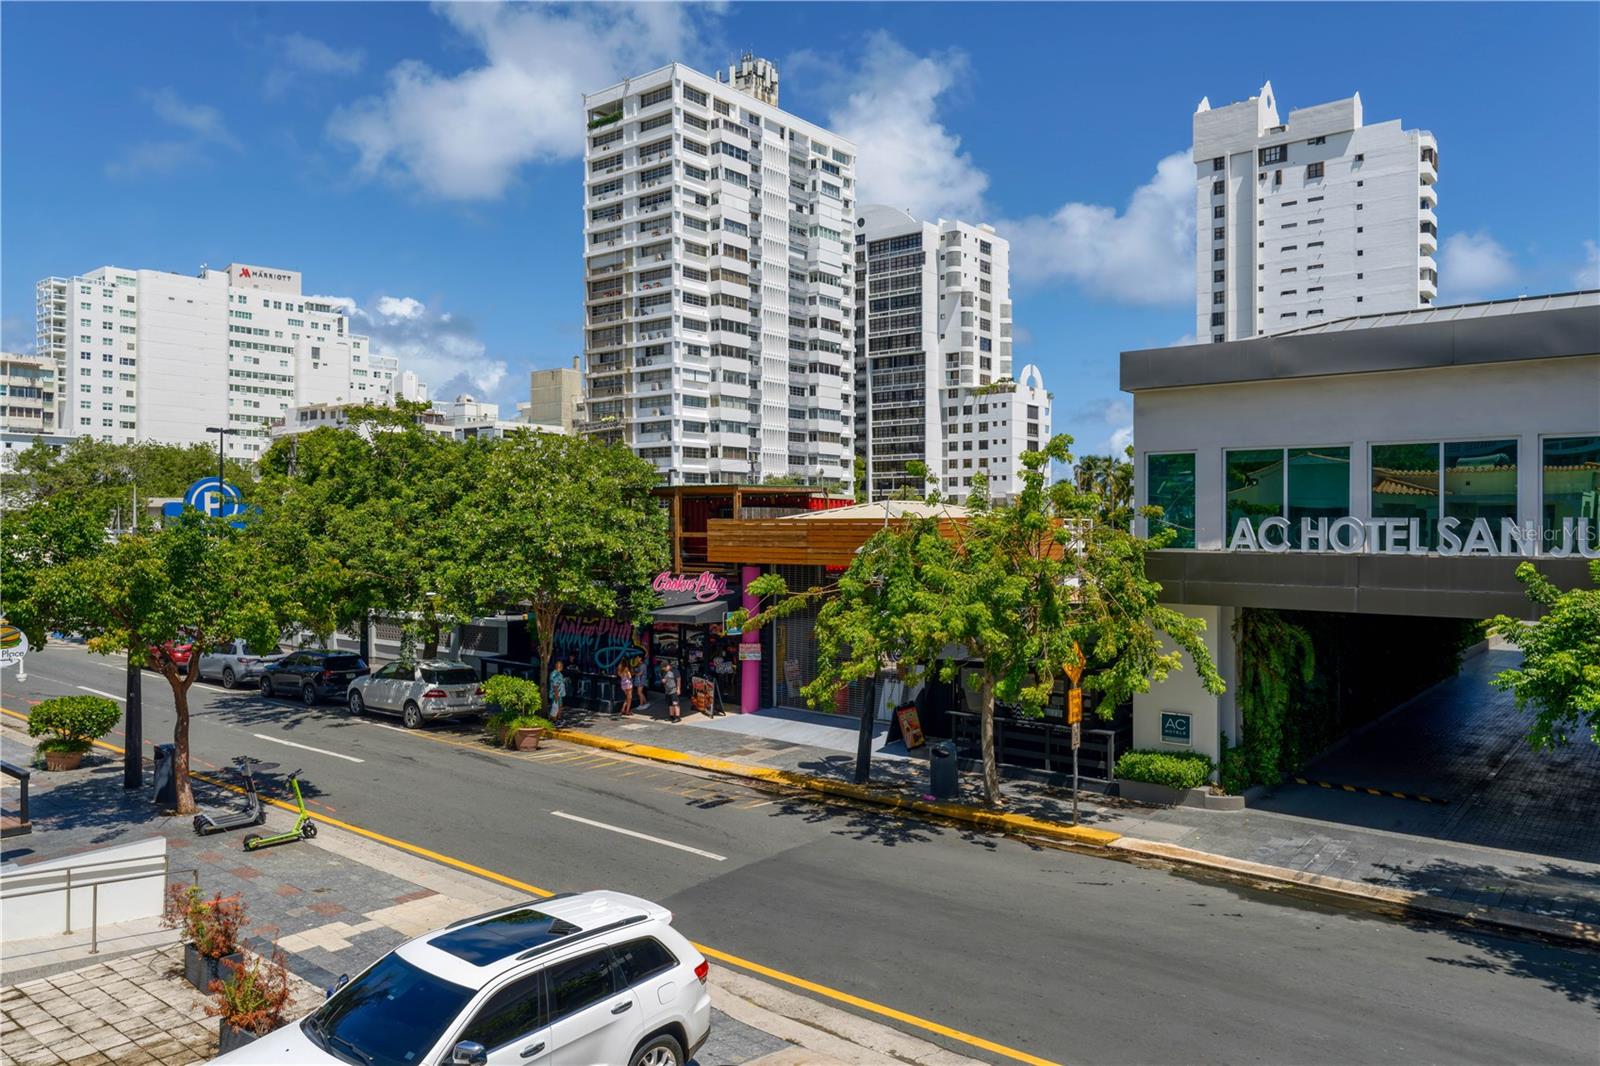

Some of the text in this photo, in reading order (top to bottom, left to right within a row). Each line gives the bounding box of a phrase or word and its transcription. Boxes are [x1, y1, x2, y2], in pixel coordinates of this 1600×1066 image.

[252, 271, 292, 282] MARRIOTT
[1229, 516, 1291, 553] AC
[1301, 516, 1428, 555] HOTEL
[1436, 516, 1537, 557] SAN
[652, 570, 734, 602] Cookie Plug
[2, 649, 25, 659] Place
[1165, 718, 1186, 731] AC
